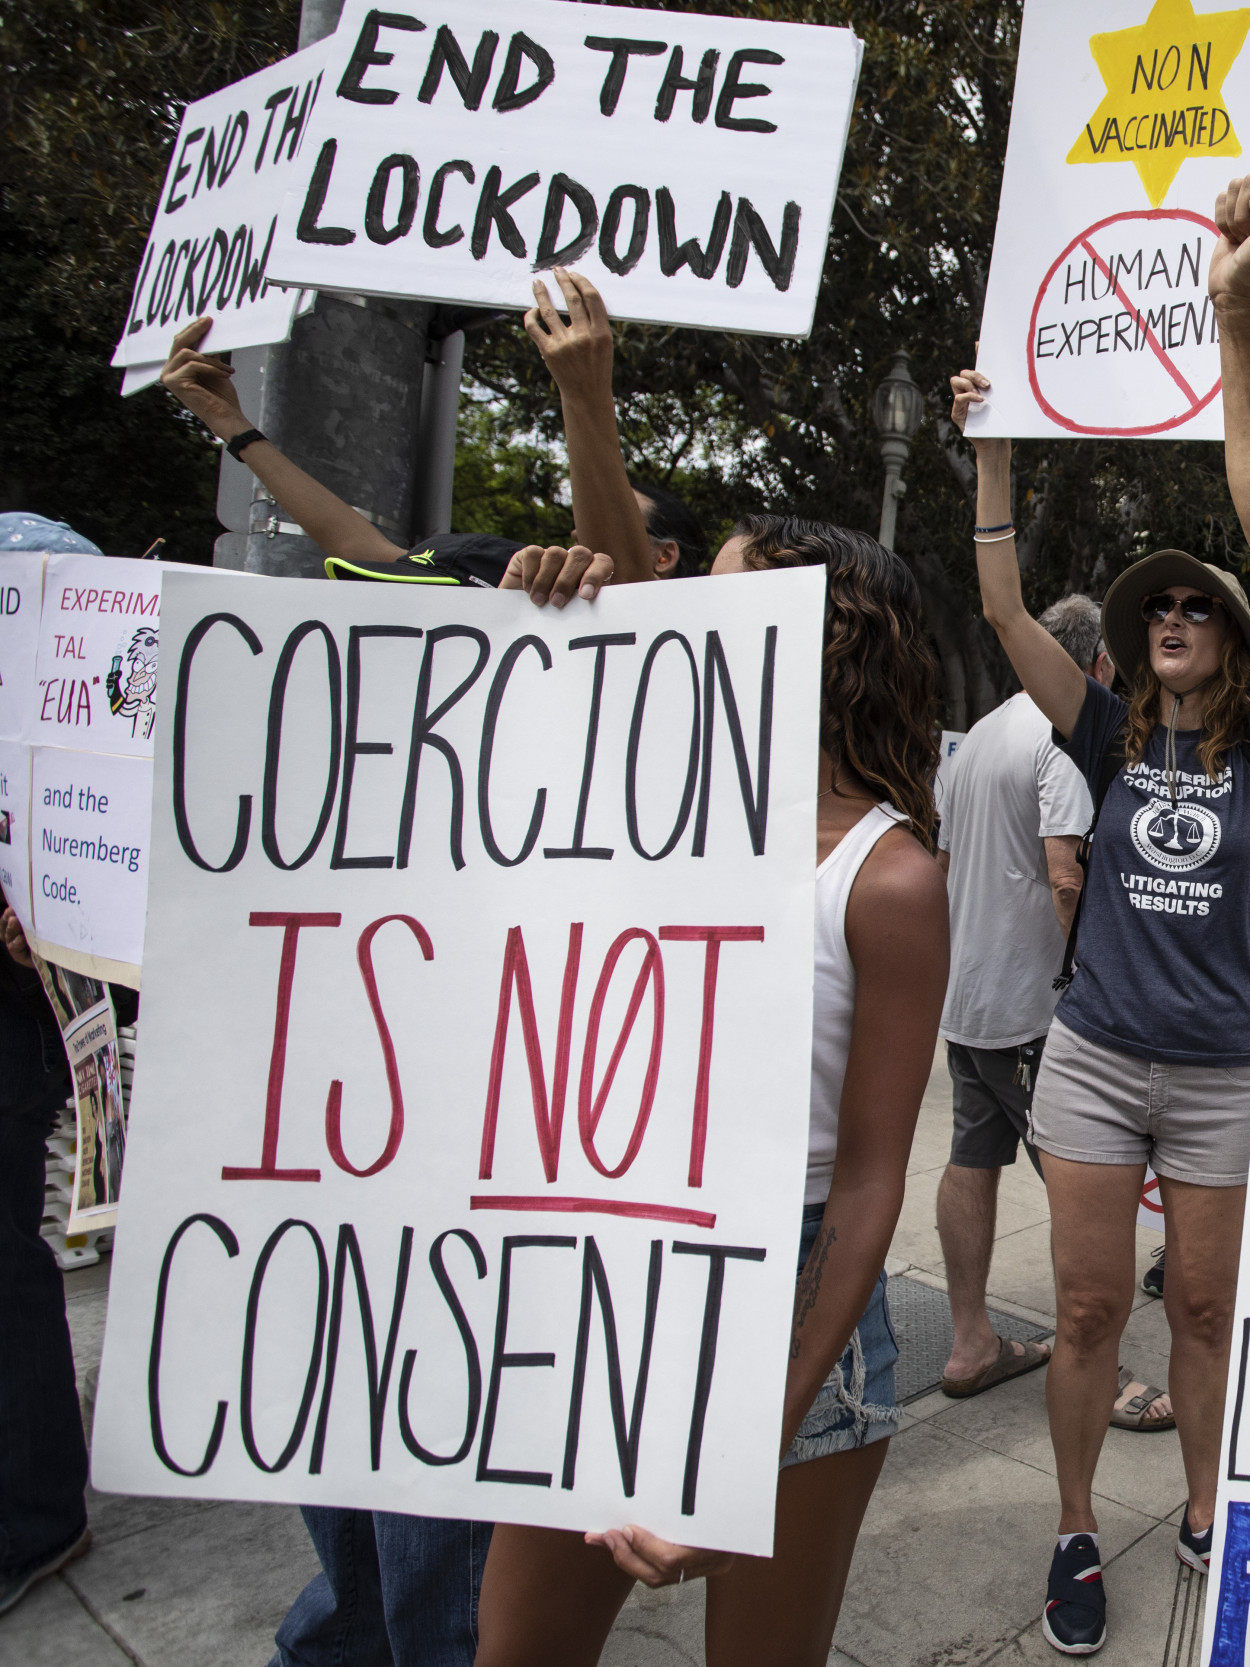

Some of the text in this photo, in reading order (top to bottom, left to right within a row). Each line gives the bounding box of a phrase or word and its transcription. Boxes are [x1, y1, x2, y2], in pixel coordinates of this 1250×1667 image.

[336, 8, 786, 134] END THE
[1131, 42, 1211, 94] NON
[164, 69, 324, 214] END TH
[1086, 105, 1230, 155] VACCINATED
[295, 137, 802, 292] LOCKDOWN
[127, 214, 288, 336] LOCKDOW
[1064, 237, 1201, 304] HUMAN
[1036, 295, 1220, 359] EXPERIMENT
[60, 587, 161, 617] EXPERIM
[54, 635, 86, 660] TAL
[173, 612, 778, 873] COERCION
[44, 784, 109, 815] and the
[1123, 775, 1232, 799] CORRUPTION
[42, 827, 142, 872] Nuremberg
[42, 874, 81, 905] Code.
[1121, 872, 1223, 898] LITIGATING
[1128, 892, 1210, 917] RESULTS
[221, 912, 435, 1181] IS
[149, 1212, 766, 1517] CONSENT
